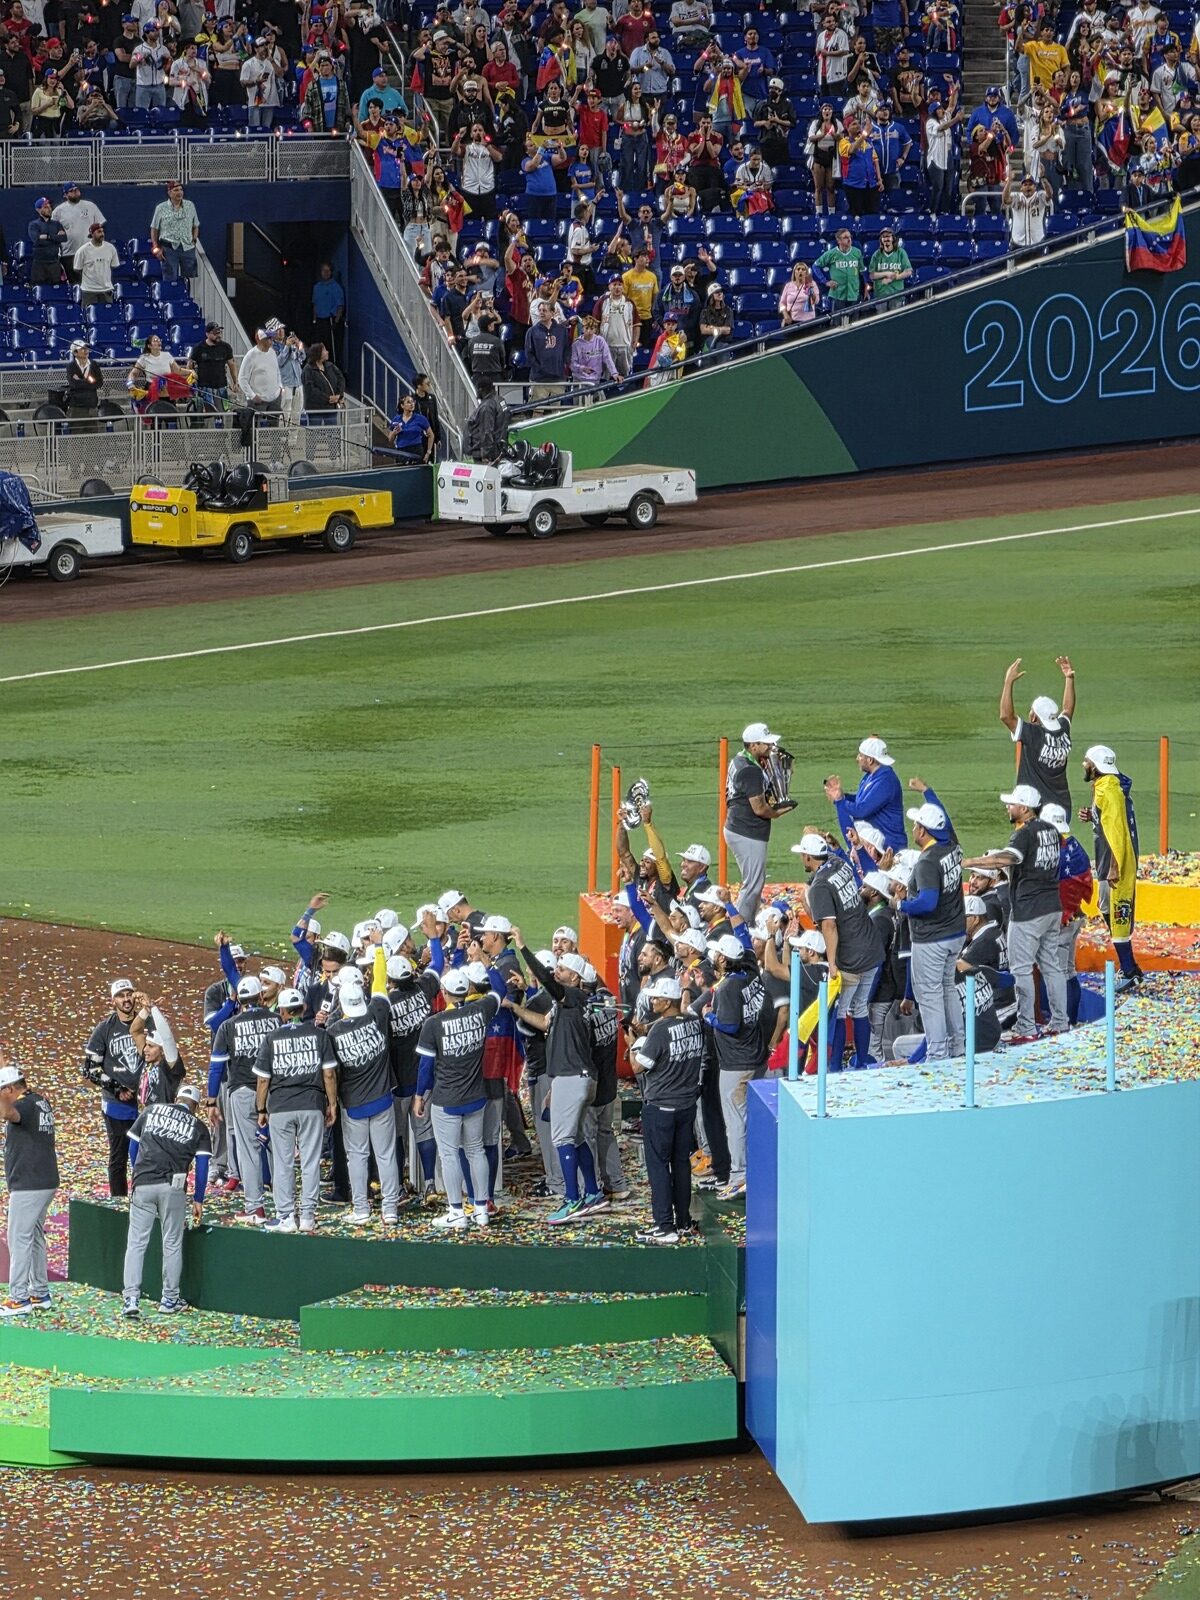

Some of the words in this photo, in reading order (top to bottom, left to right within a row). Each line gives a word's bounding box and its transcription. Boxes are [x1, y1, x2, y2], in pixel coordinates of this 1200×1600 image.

[964, 281, 1200, 412] 2026
[235, 1020, 256, 1036] THE
[256, 1017, 280, 1033] BEST
[335, 1030, 355, 1050] THE
[353, 1020, 380, 1042] BEST
[442, 1018, 463, 1036] THE
[461, 1011, 485, 1032] BEST
[668, 1025, 687, 1042] THE
[272, 1038, 293, 1054] THE
[292, 1034, 318, 1053] BEST
[336, 1030, 386, 1063] BASEBALL
[272, 1050, 321, 1069] BASEBALL
[145, 1113, 195, 1139] BASEBALL
[151, 1104, 174, 1118] THE
[171, 1108, 198, 1126] BEST
